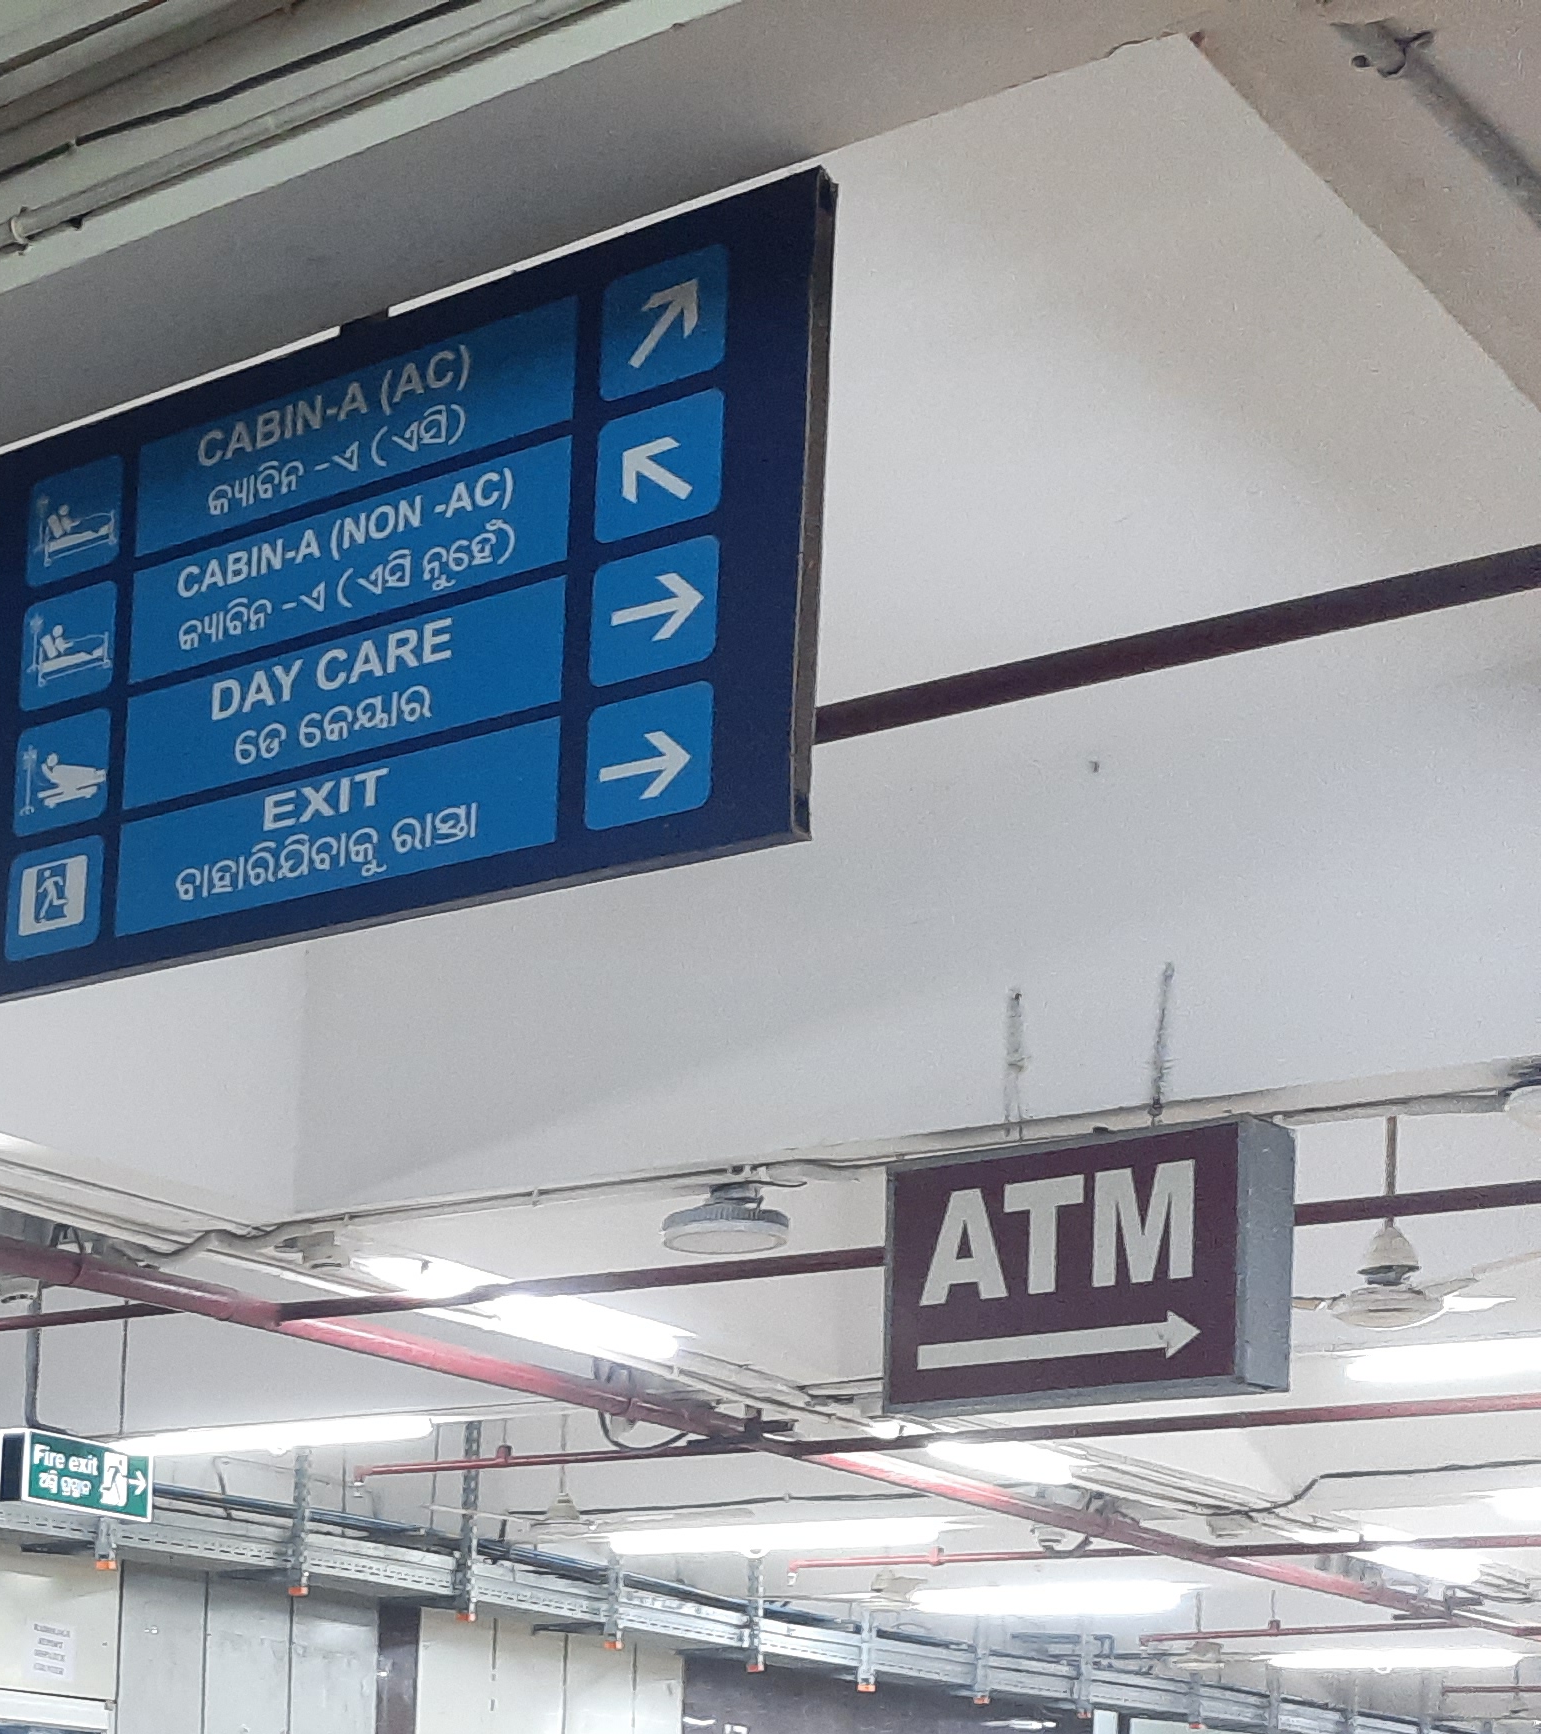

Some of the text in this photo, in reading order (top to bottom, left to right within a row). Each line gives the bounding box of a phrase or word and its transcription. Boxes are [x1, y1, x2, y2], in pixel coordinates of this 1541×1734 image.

[197, 344, 471, 467] CABIN-A (AC)
[177, 467, 514, 598] CABIN-A (NON -AC)
[210, 617, 453, 721] DAY CARE
[261, 767, 390, 832] EXIT
[920, 1158, 1196, 1308] ATM
[33, 1443, 99, 1476] Fire exit
